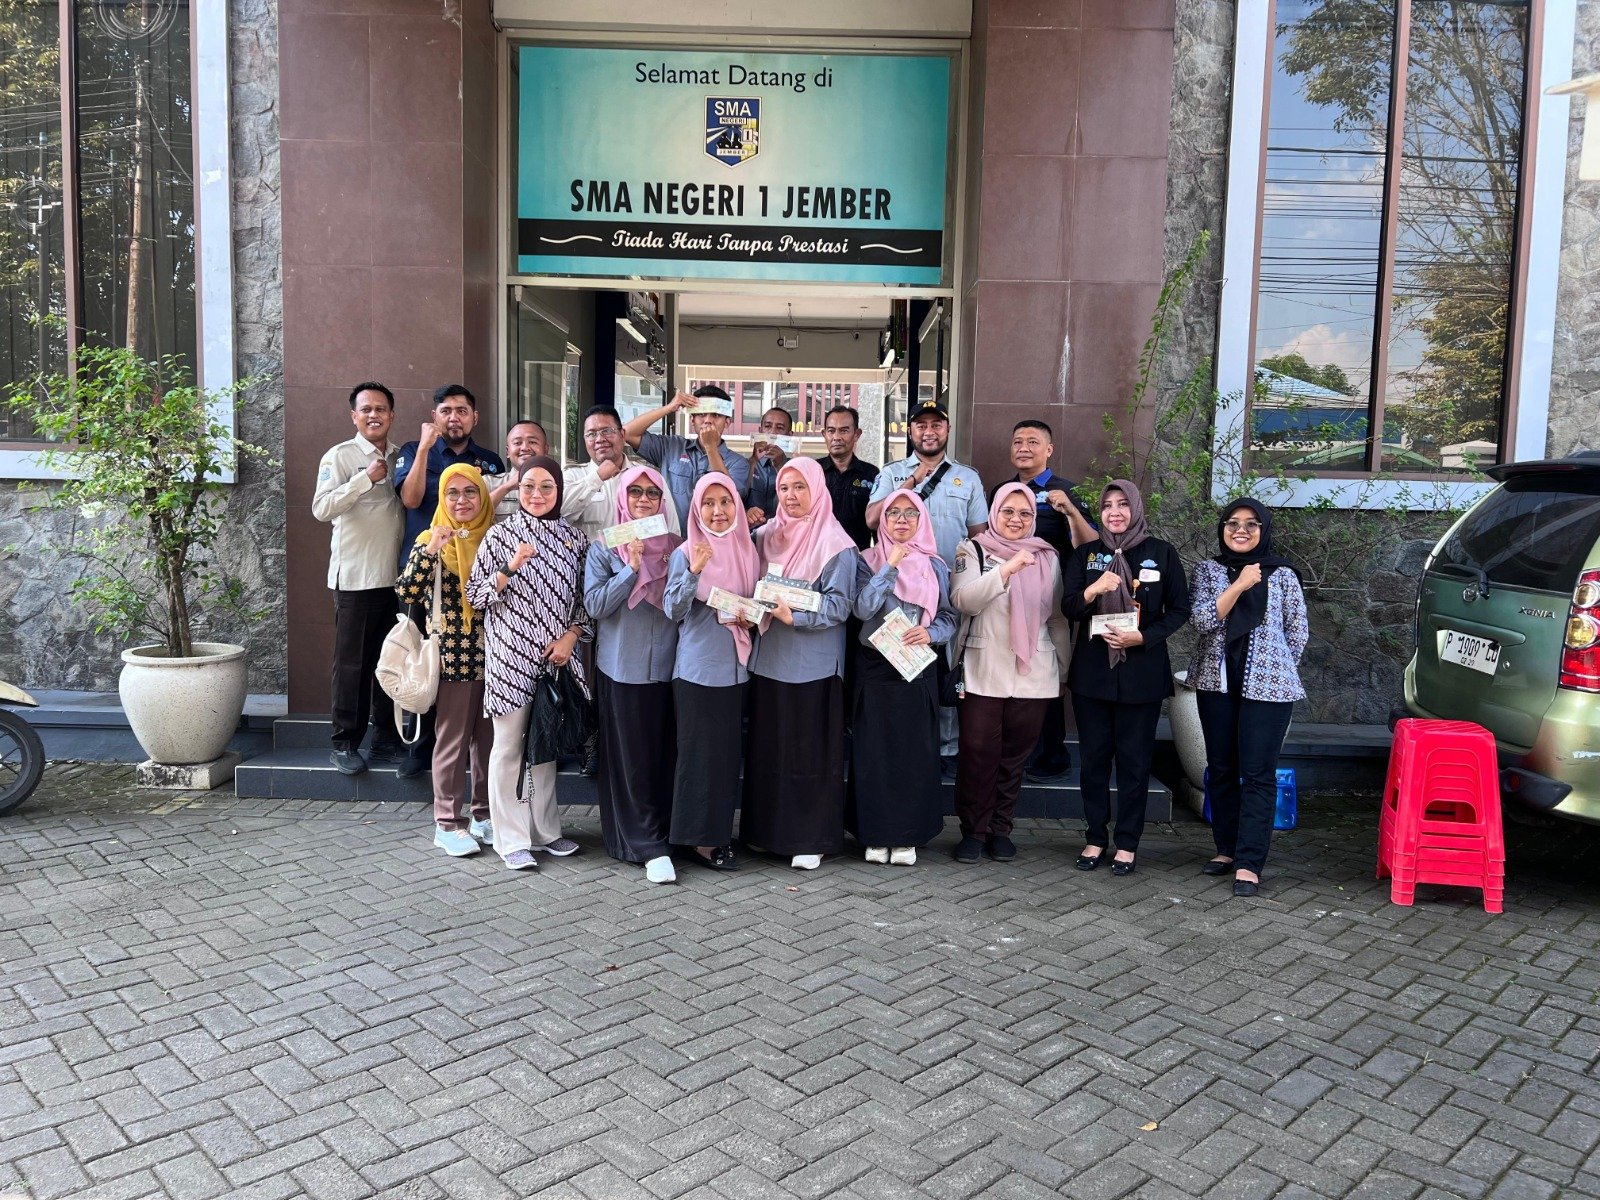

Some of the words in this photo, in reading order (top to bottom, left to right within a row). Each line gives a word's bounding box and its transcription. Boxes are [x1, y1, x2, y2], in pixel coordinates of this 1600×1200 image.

[635, 62, 721, 85] Selamat
[728, 64, 807, 93] Datang
[813, 66, 833, 88] di
[714, 100, 752, 117] SMA
[570, 178, 633, 213] SMA
[643, 182, 744, 217] NEGERI
[759, 185, 769, 217] 1
[782, 186, 891, 221] JEMBER
[611, 229, 665, 249] Tiada
[668, 231, 713, 250] Hari
[716, 232, 774, 257] Tanpa
[777, 234, 849, 254] Prestasi
[1518, 606, 1556, 619] XENIA
[1446, 632, 1453, 649] P
[1458, 636, 1481, 657] 1909
